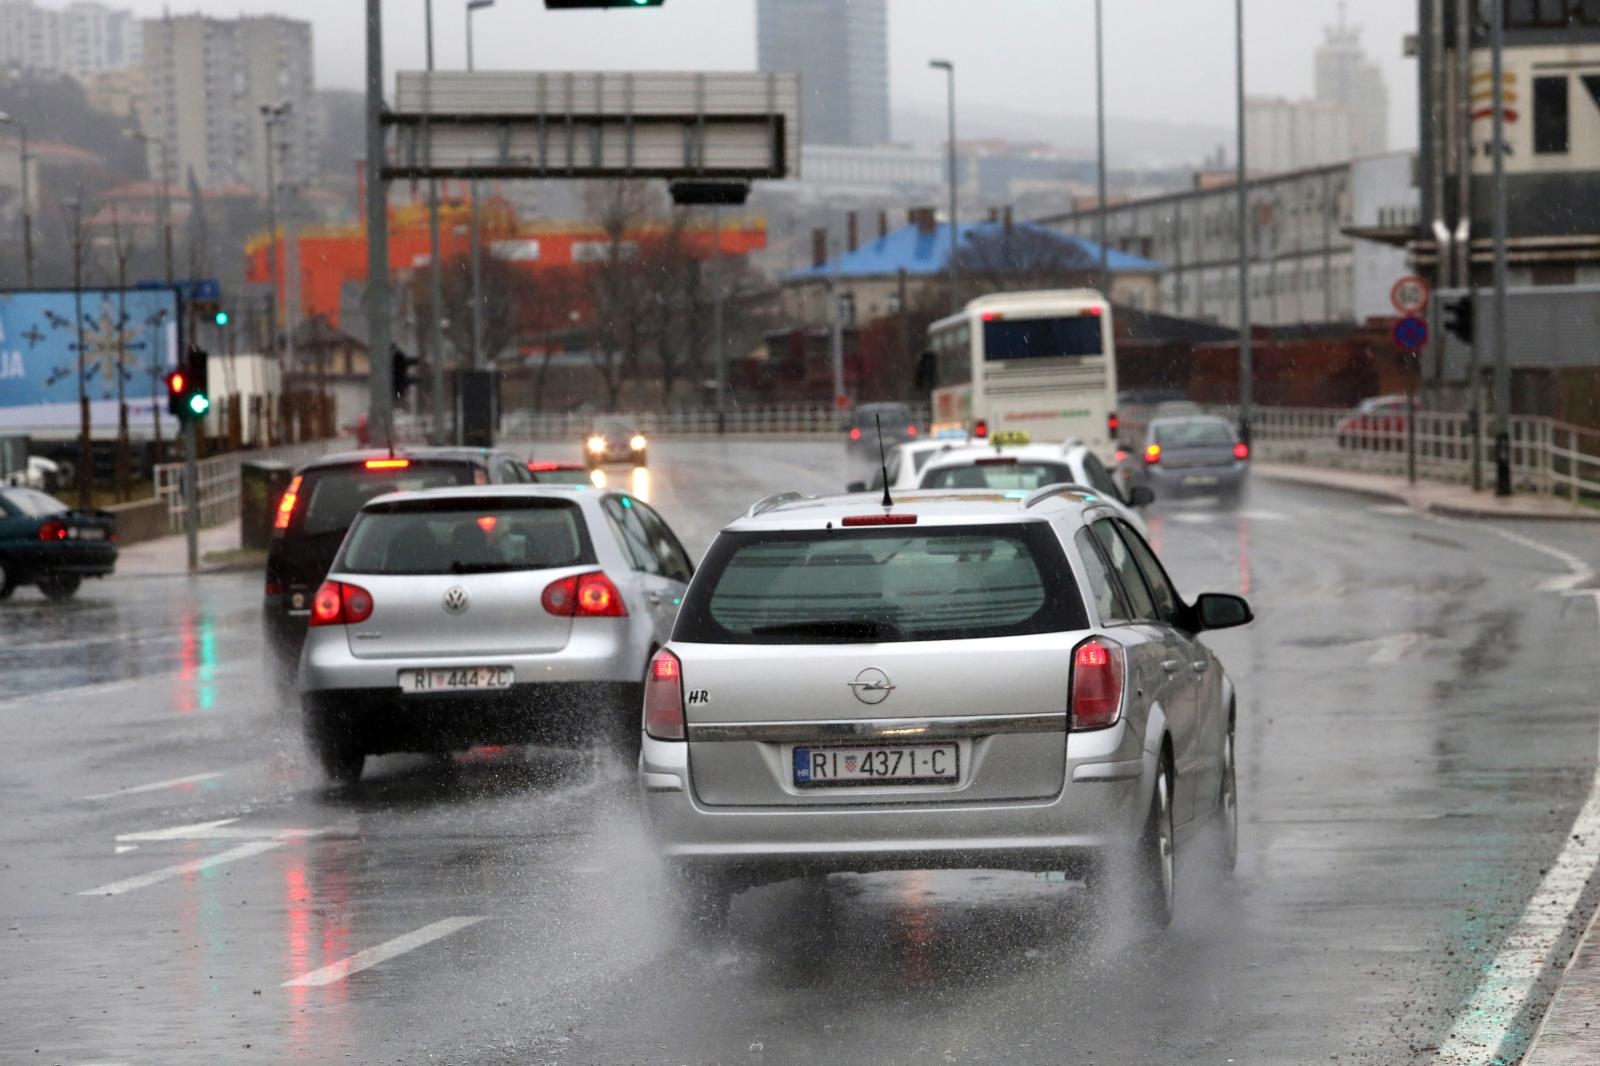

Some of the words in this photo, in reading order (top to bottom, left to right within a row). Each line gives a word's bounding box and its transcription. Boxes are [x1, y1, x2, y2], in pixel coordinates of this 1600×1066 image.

[415, 671, 432, 689] RI
[688, 690, 708, 704] HR
[813, 752, 837, 778] RI
[859, 749, 946, 777] 4371-C
